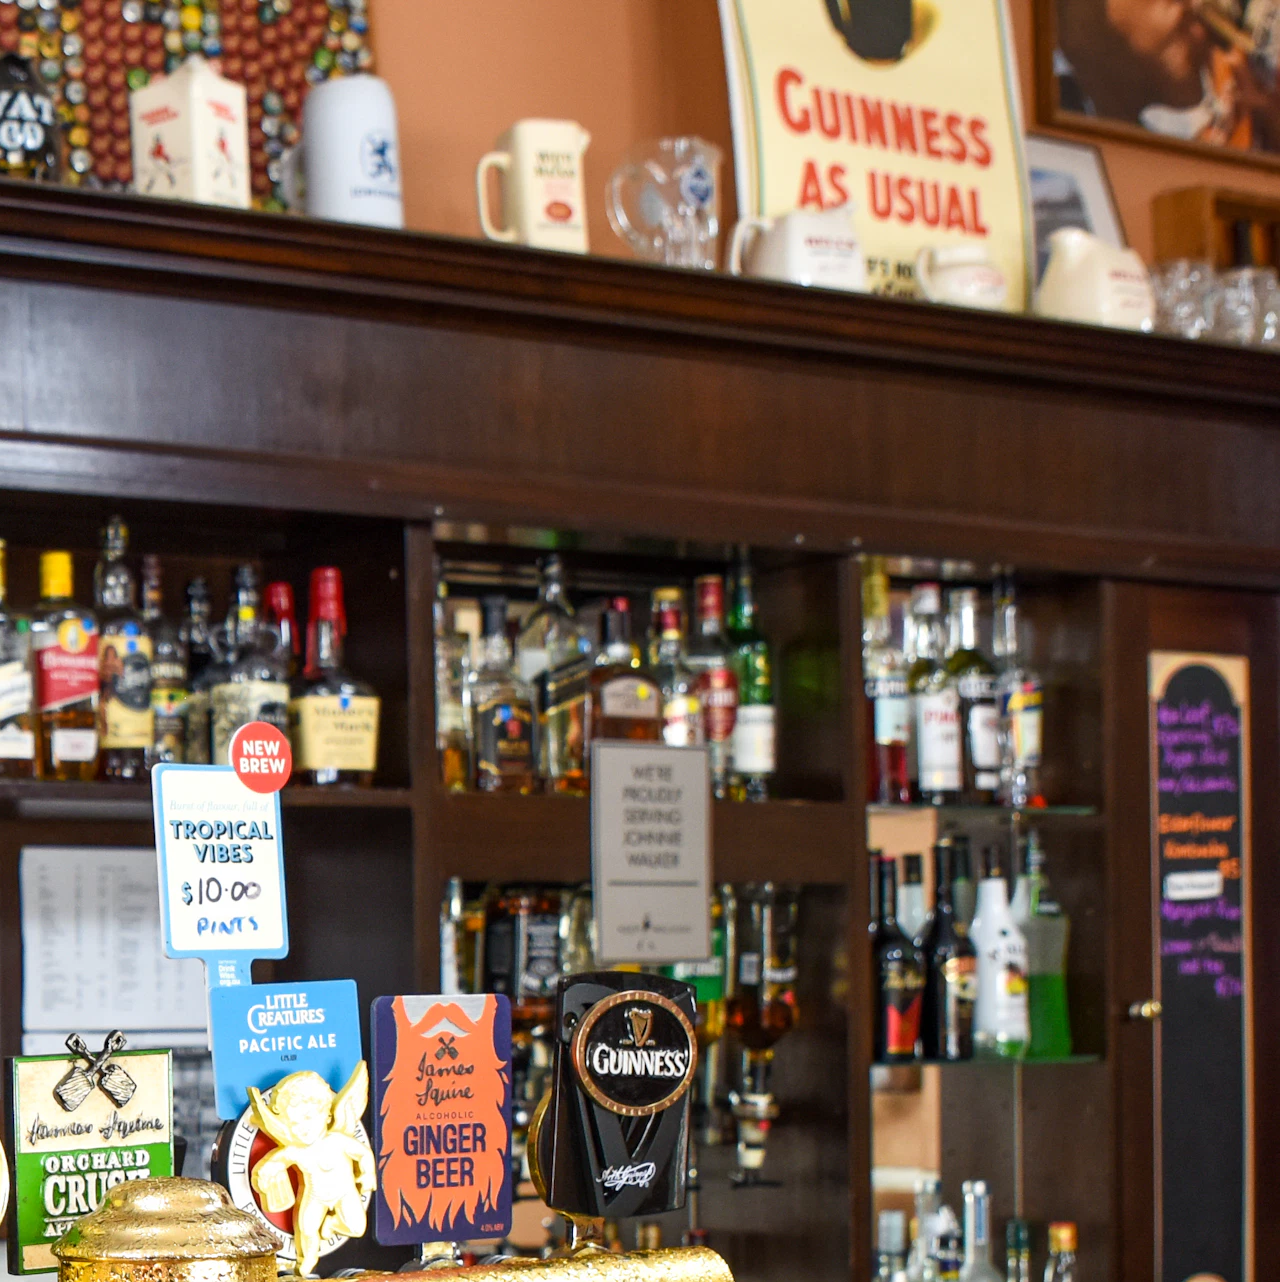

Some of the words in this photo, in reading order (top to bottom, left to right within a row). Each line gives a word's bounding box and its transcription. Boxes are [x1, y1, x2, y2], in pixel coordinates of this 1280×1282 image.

[774, 66, 994, 169] GUINNESS
[797, 159, 852, 212] AS
[867, 168, 989, 239] USUAL
[243, 740, 280, 756] NEW
[239, 757, 285, 774] BREW
[169, 820, 273, 840] TROPICAL
[193, 844, 254, 863] VIBES
[197, 916, 258, 936] PINTS
[266, 993, 308, 1010] LITTLE
[247, 1004, 325, 1034] CREATURES
[239, 1036, 303, 1053] PACIFIC
[308, 1033, 337, 1049] ALE
[416, 1051, 474, 1081] James
[592, 1043, 685, 1077] GUINNESS
[416, 1081, 474, 1106] Squire
[415, 1110, 474, 1120] ALCOHOLIC
[233, 1121, 255, 1175] LITTLE
[403, 1122, 486, 1156] GINGER
[44, 1149, 150, 1174] ORCHARD
[416, 1158, 474, 1189] BEER
[43, 1170, 151, 1217] CRU
